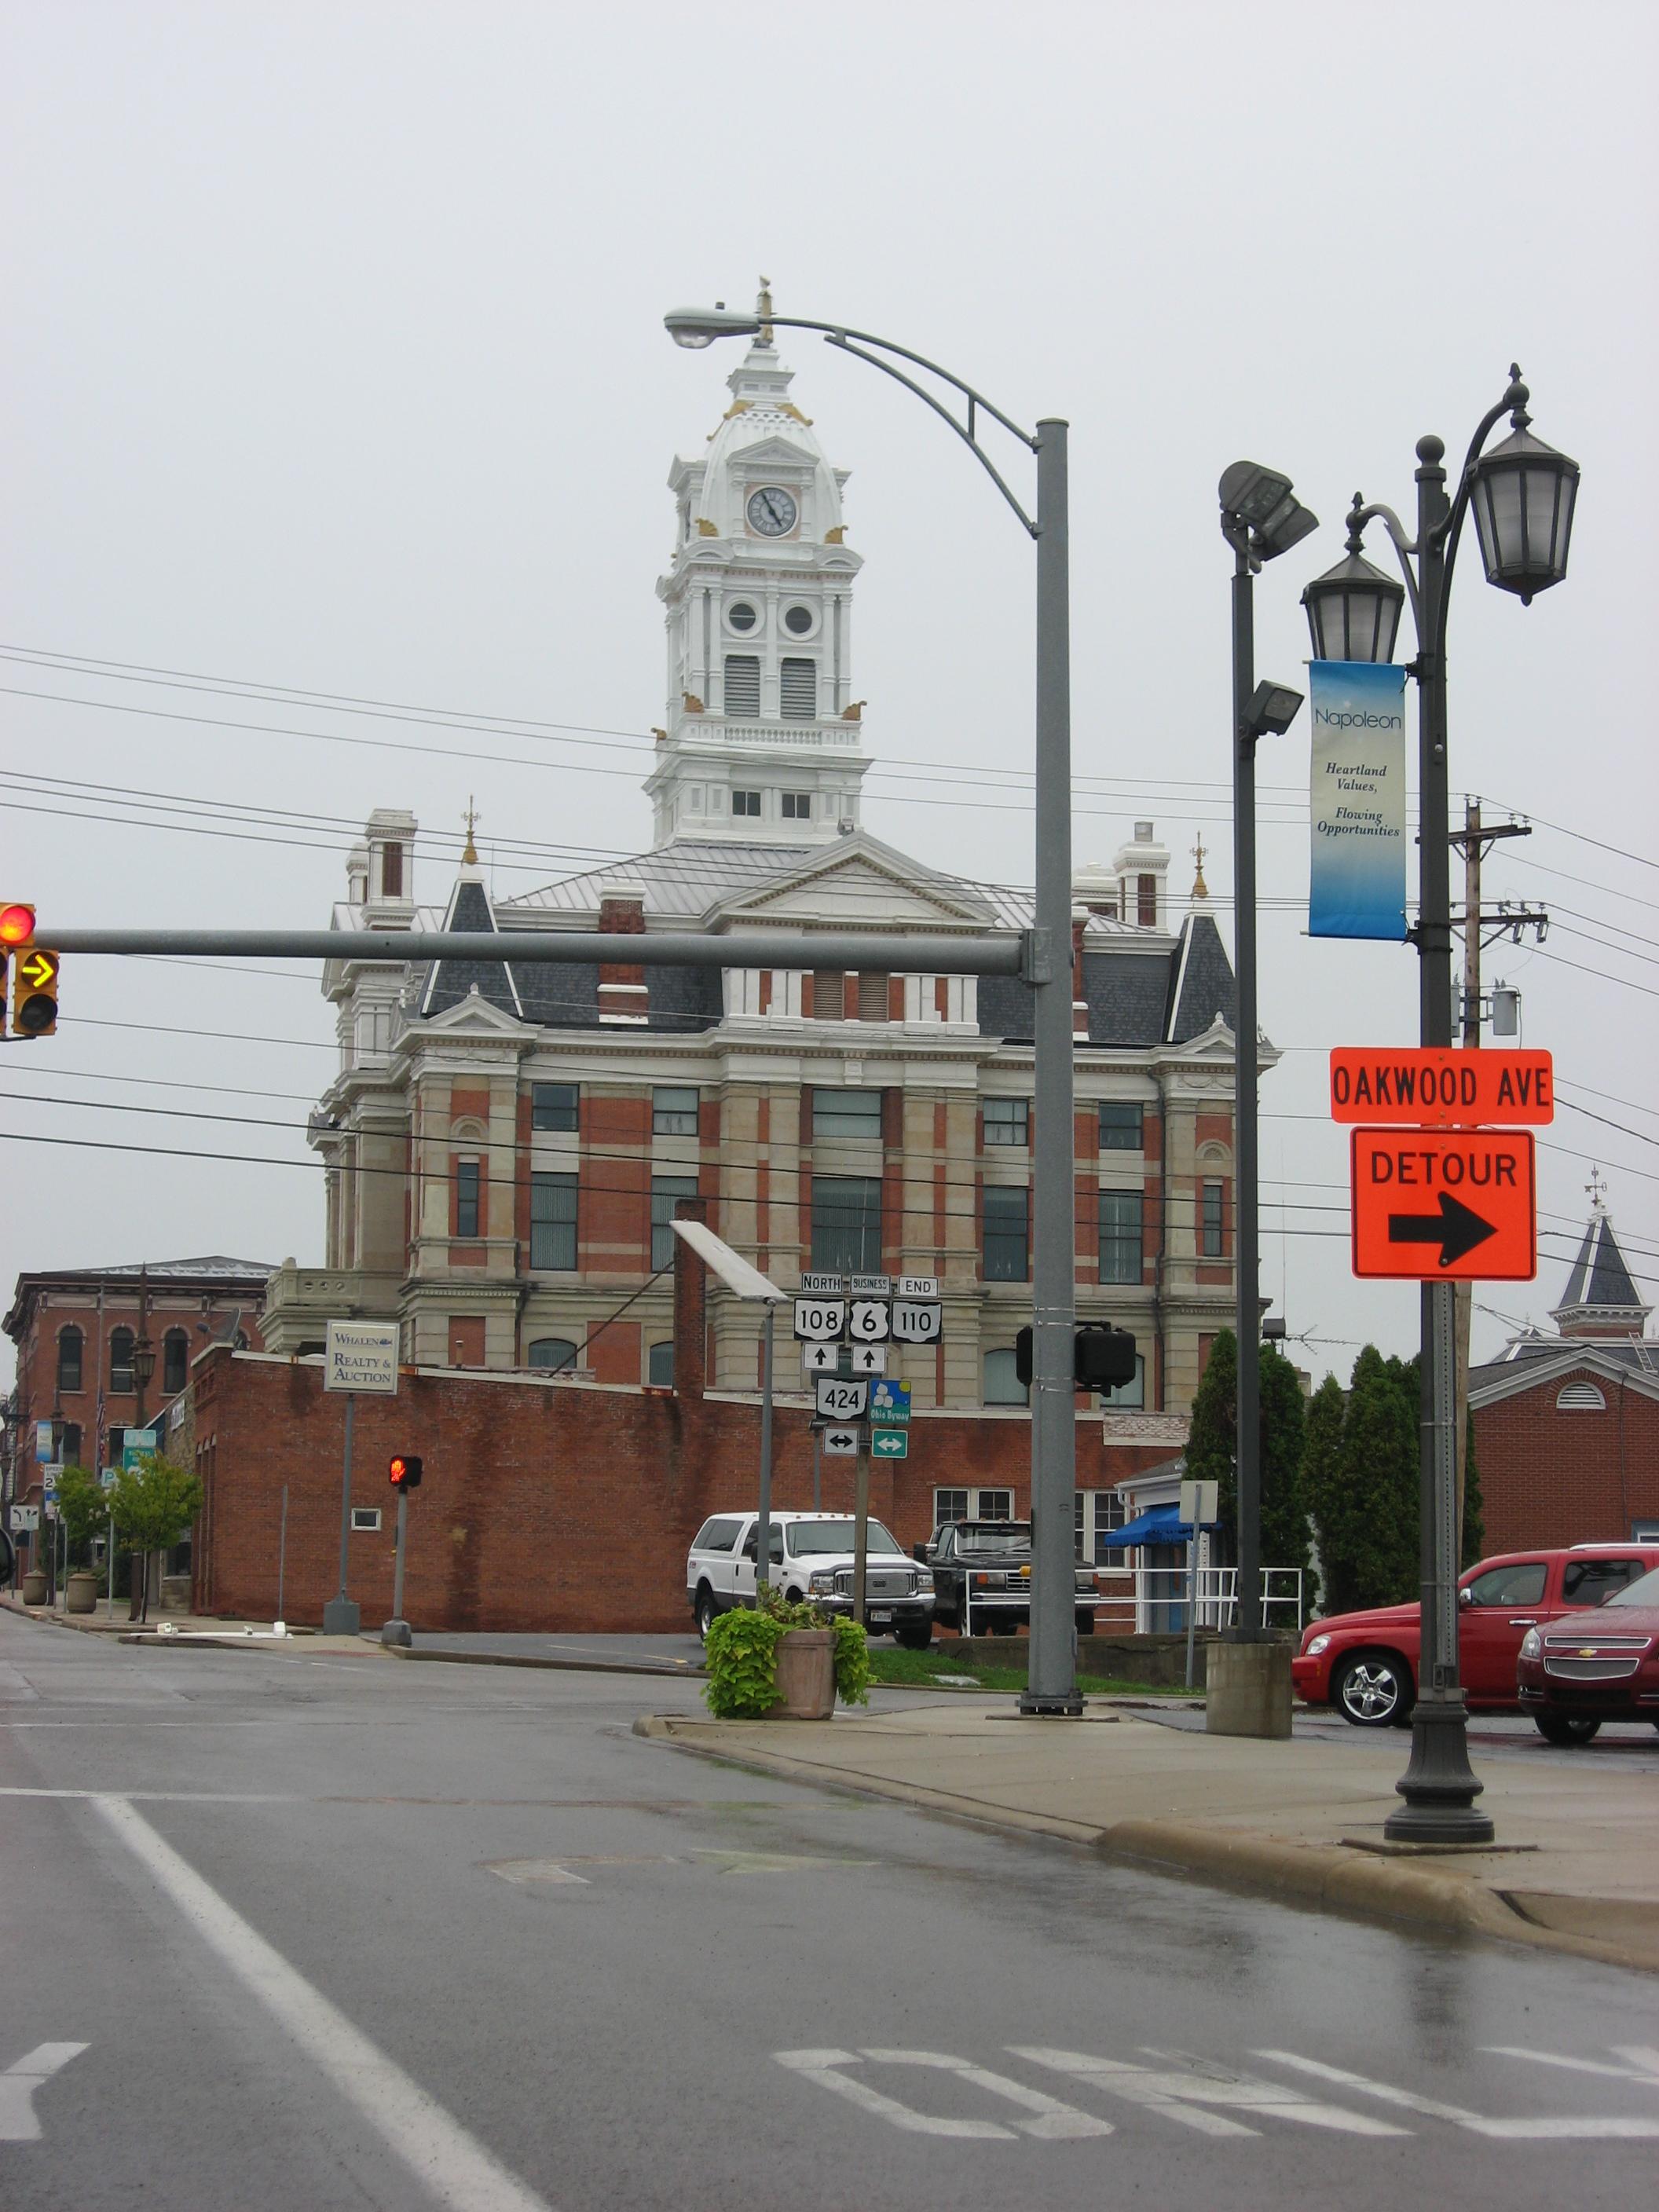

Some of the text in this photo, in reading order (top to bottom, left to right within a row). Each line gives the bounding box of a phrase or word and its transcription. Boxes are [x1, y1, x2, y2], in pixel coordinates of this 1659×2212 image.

[1315, 709, 1402, 730] Napoleon
[1325, 761, 1388, 777] Heartland
[1337, 778, 1378, 793] Values,
[1335, 806, 1383, 826] Flowing
[1317, 820, 1401, 837] Opportunities
[1333, 1065, 1551, 1107] OAKWOOD AVE
[1371, 1150, 1517, 1187] DETOUR
[804, 1275, 840, 1290] NORTH
[854, 1276, 887, 1290] BUSINESS
[905, 1280, 931, 1293] END
[801, 1309, 838, 1330] 108
[862, 1309, 877, 1332] 6
[902, 1312, 932, 1332] 110
[335, 1333, 379, 1345] WHALEN
[335, 1353, 379, 1367] REALTY
[334, 1368, 390, 1382] AUCTION
[825, 1389, 859, 1408] 424
[870, 1408, 910, 1421] Ohio Byway
